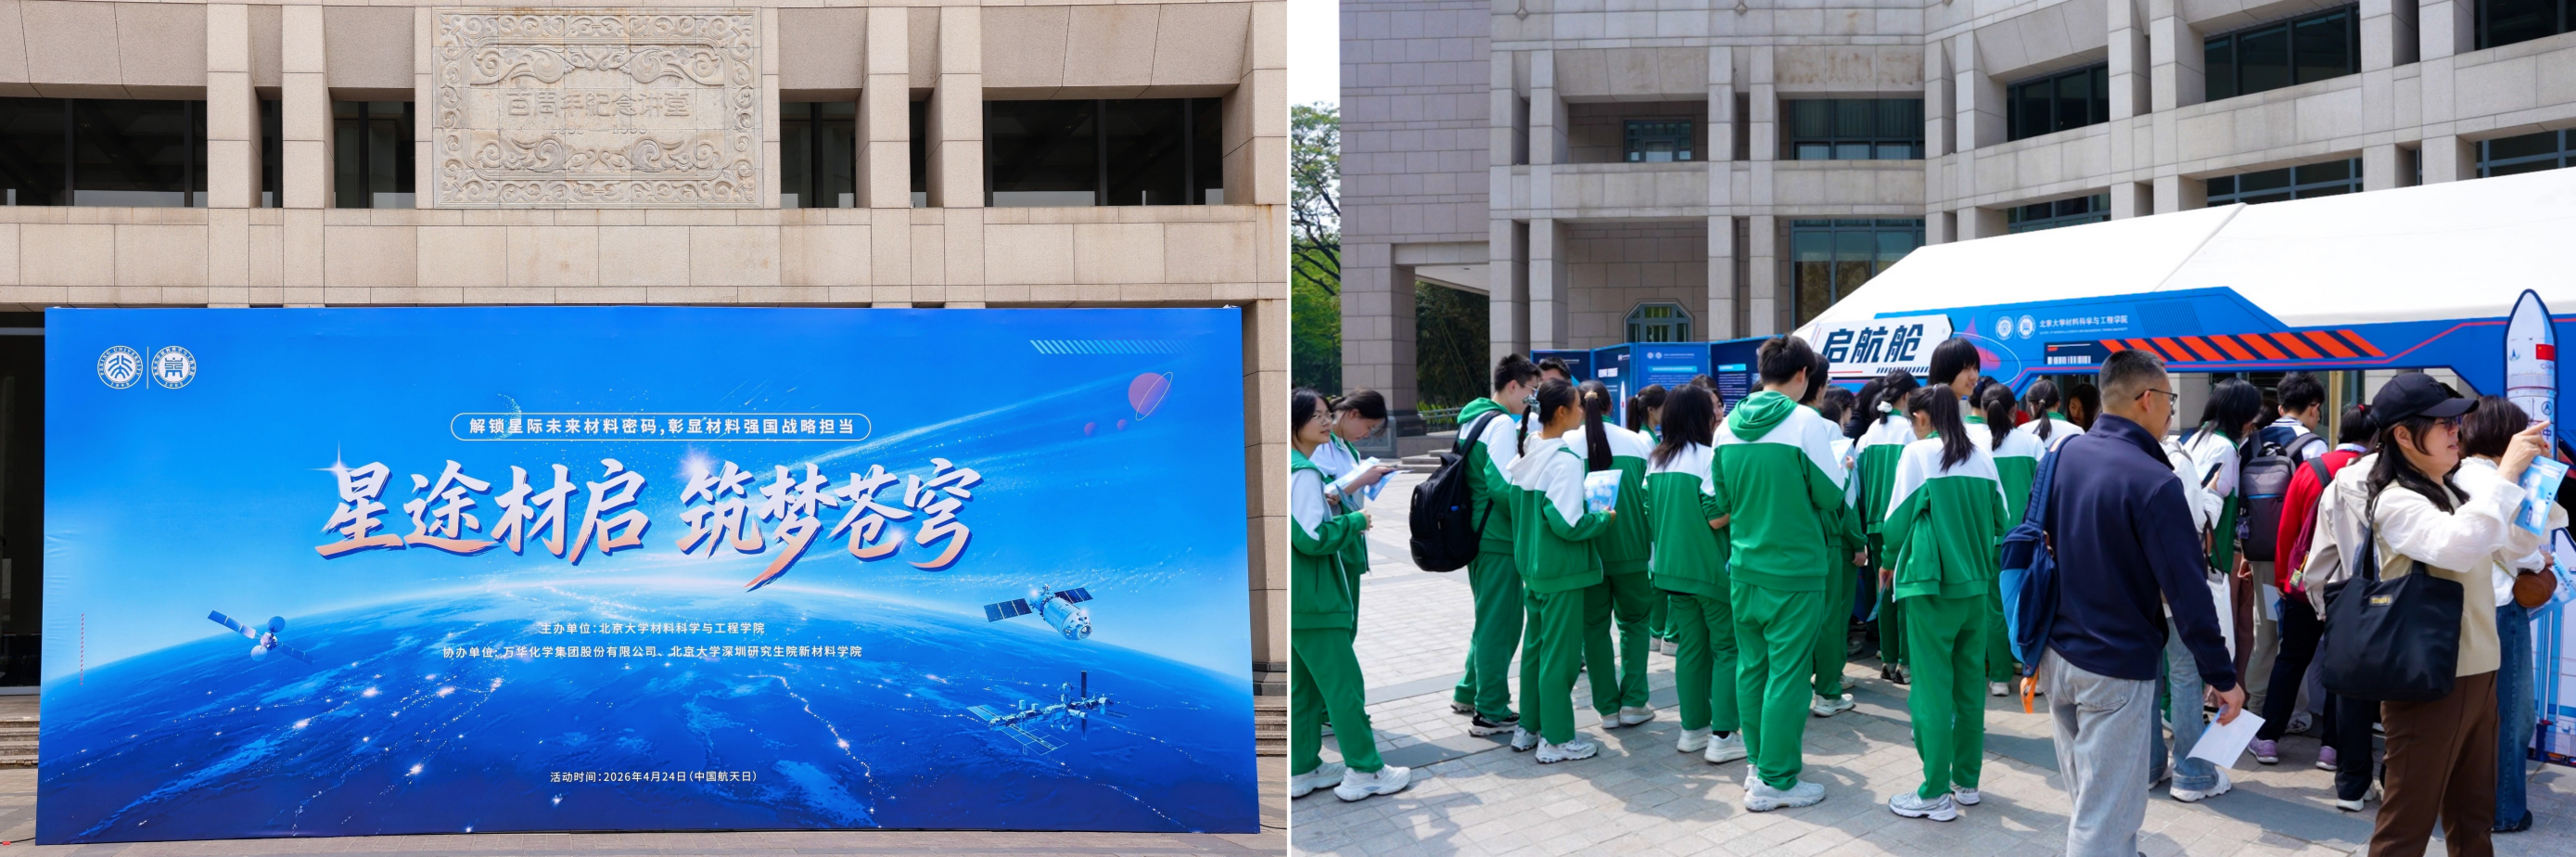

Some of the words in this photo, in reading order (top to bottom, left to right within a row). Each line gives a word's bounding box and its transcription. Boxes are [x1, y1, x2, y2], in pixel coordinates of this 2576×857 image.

[1821, 323, 1924, 364] 启航舱
[315, 458, 651, 567] 星途材启
[675, 455, 984, 592] 筑梦苍穹
